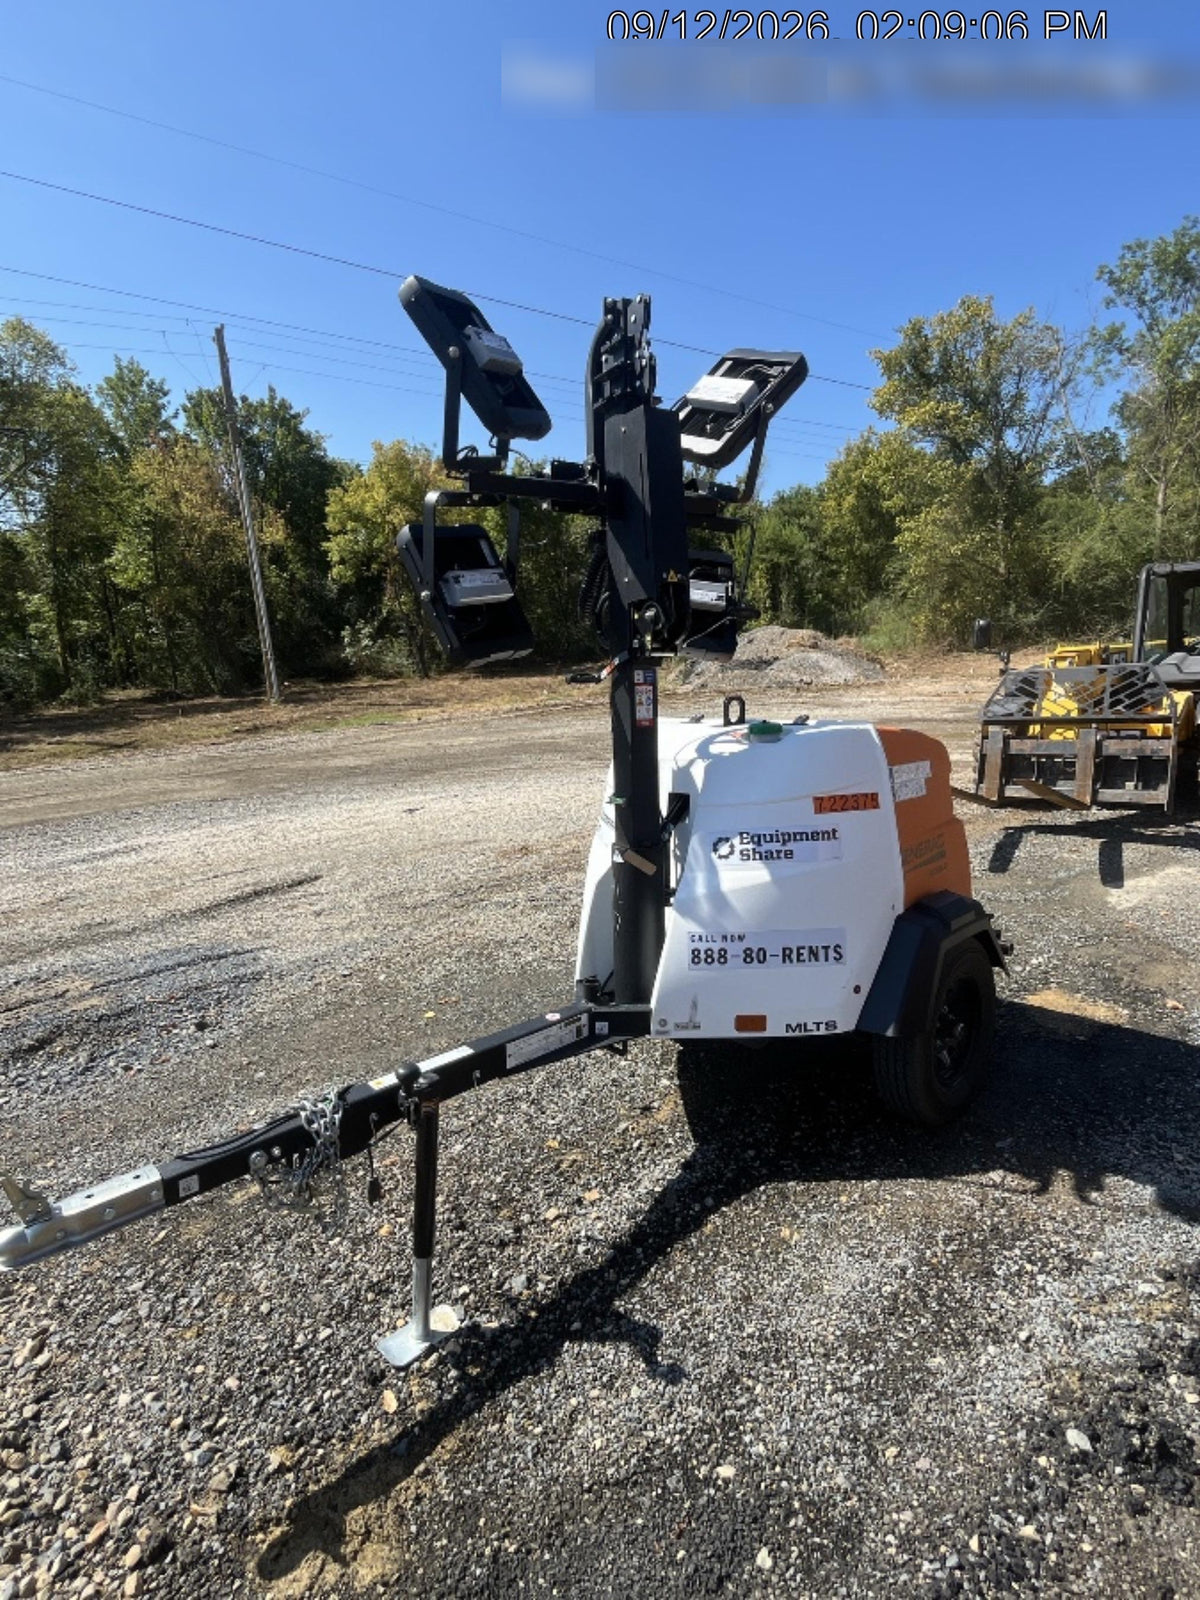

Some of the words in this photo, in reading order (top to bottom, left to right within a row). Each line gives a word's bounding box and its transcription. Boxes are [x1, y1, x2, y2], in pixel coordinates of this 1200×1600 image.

[738, 827, 839, 846] Equipment
[738, 848, 794, 861] Share
[691, 934, 717, 943] CALL
[721, 932, 746, 943] NOW
[691, 945, 844, 965] 888-80-RENTS
[785, 1020, 838, 1034] MLTS
